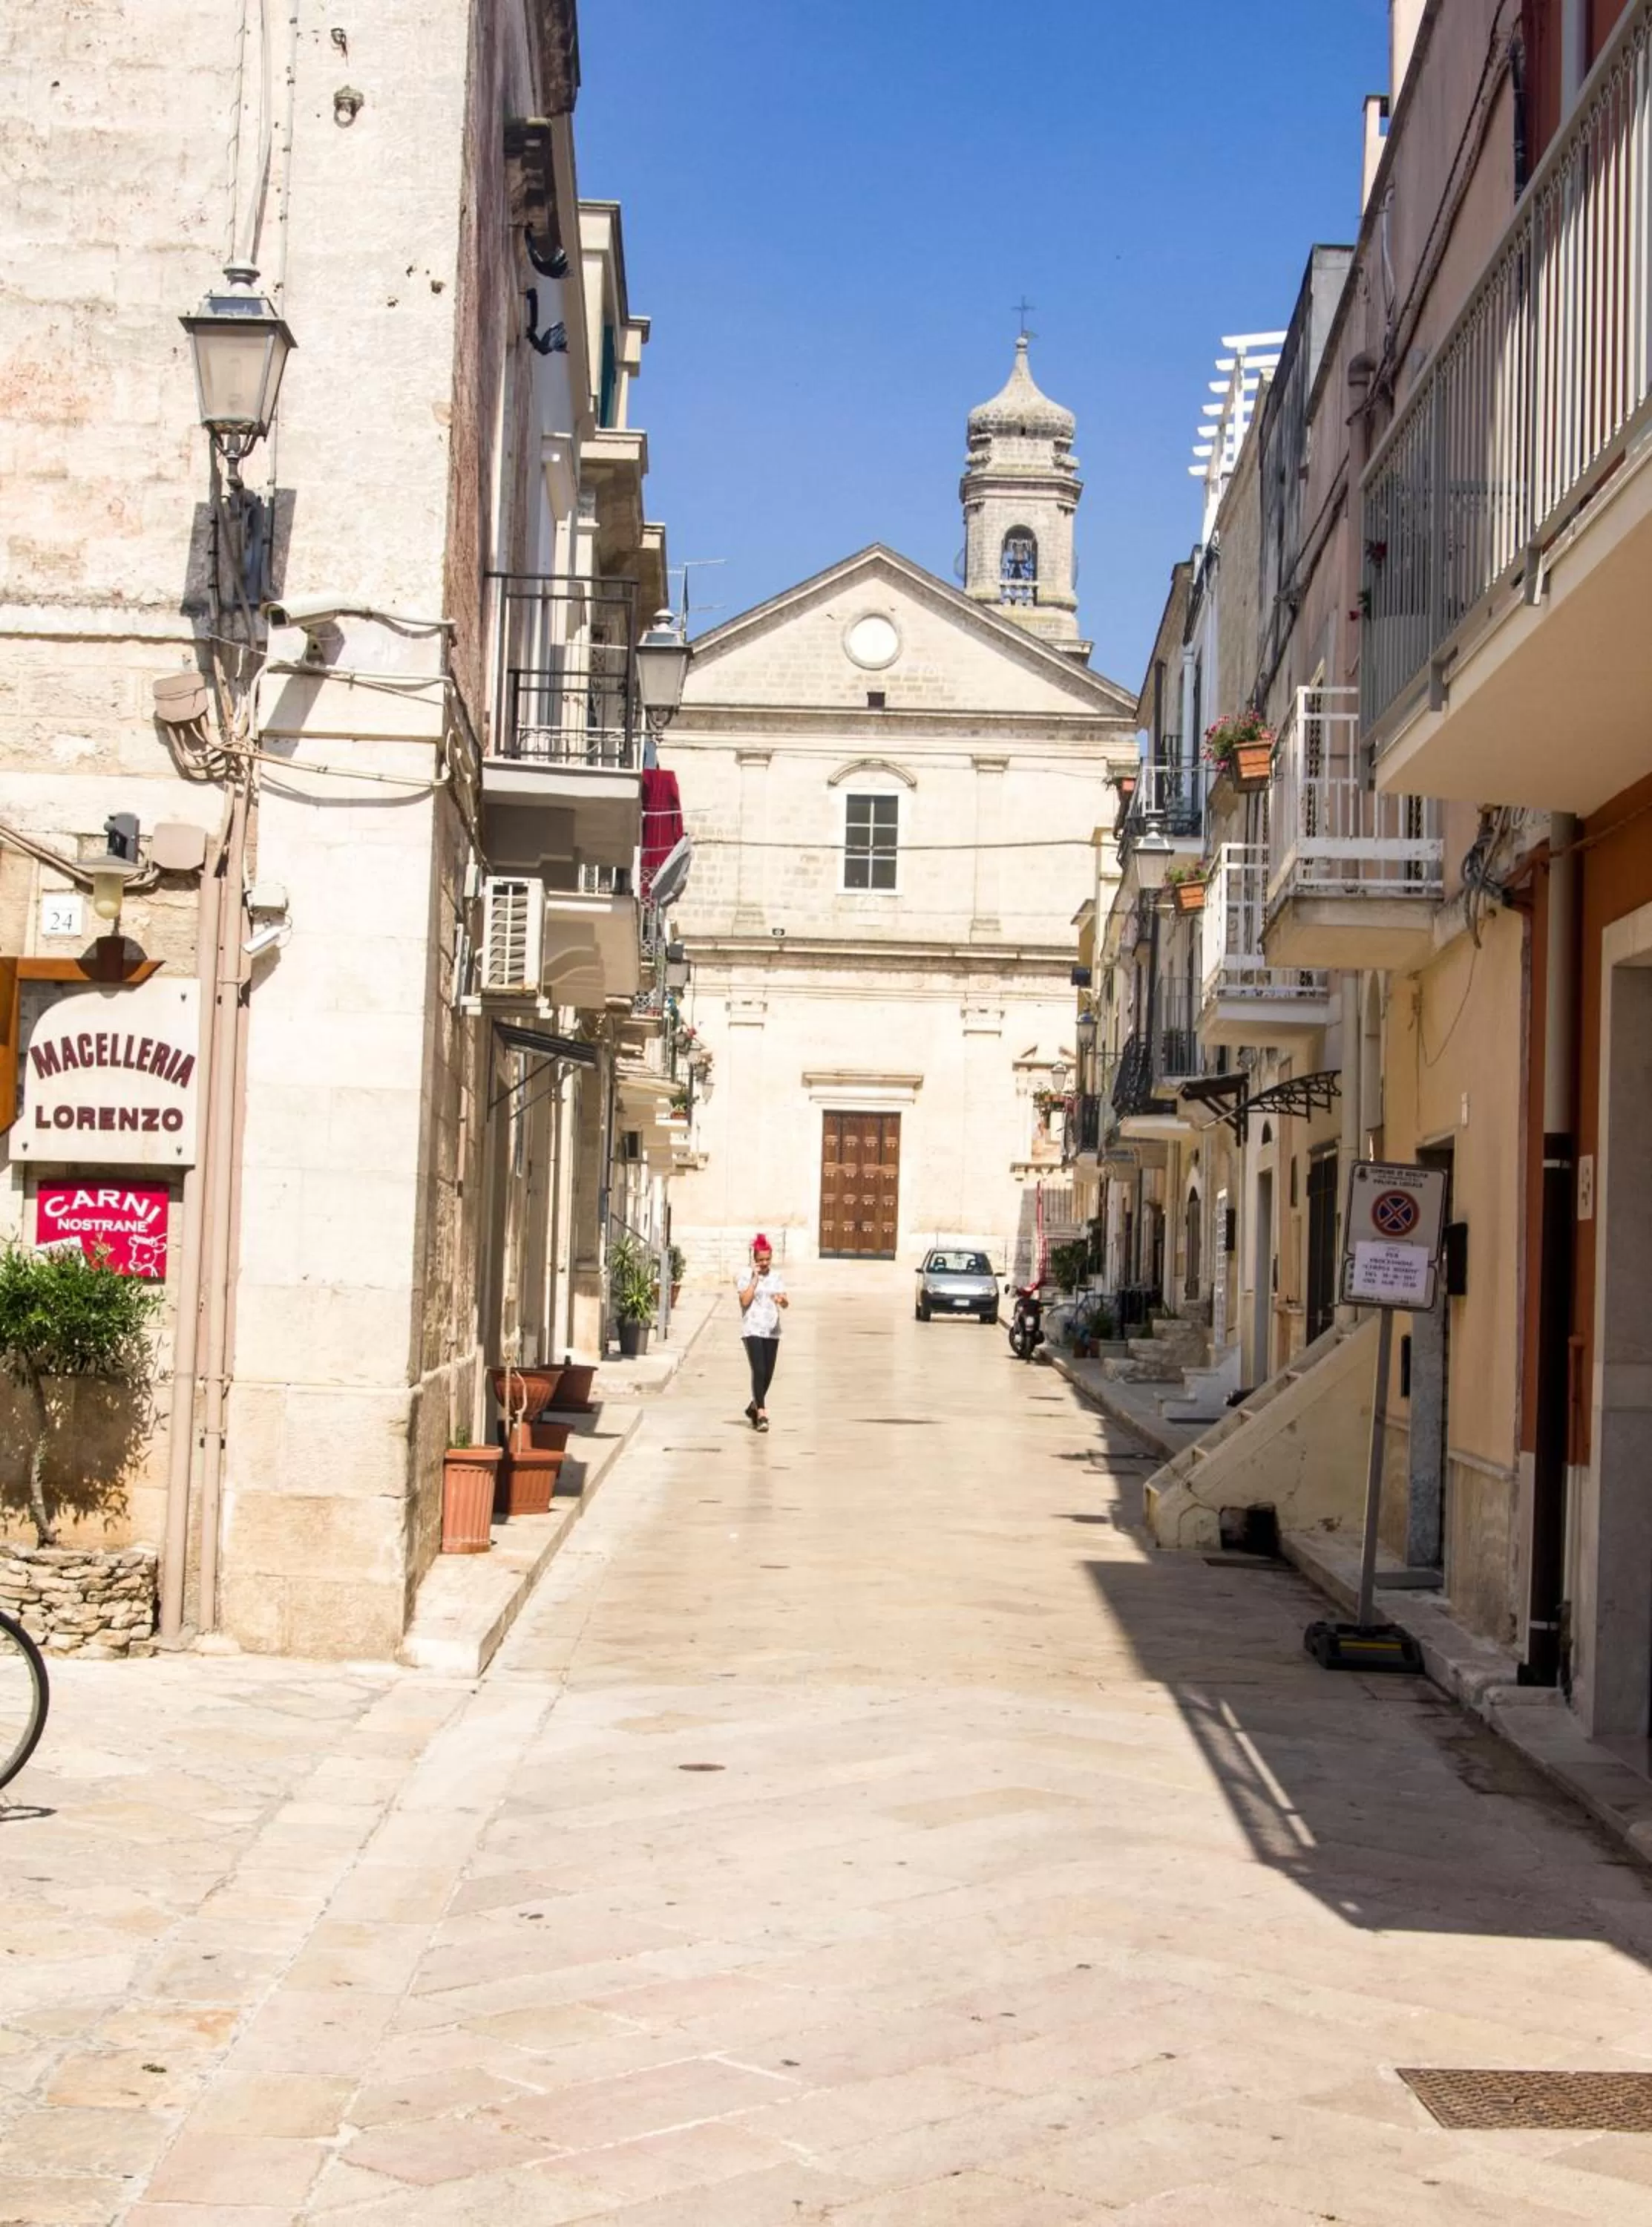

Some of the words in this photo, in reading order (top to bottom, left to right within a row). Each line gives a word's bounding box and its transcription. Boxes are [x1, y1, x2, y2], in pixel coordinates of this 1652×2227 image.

[50, 912, 72, 930] 24
[30, 1032, 196, 1089] MACELLERIA
[35, 1105, 184, 1132] LORENZO
[44, 1189, 162, 1223] CARNI
[57, 1217, 149, 1233] NOSTRANE
